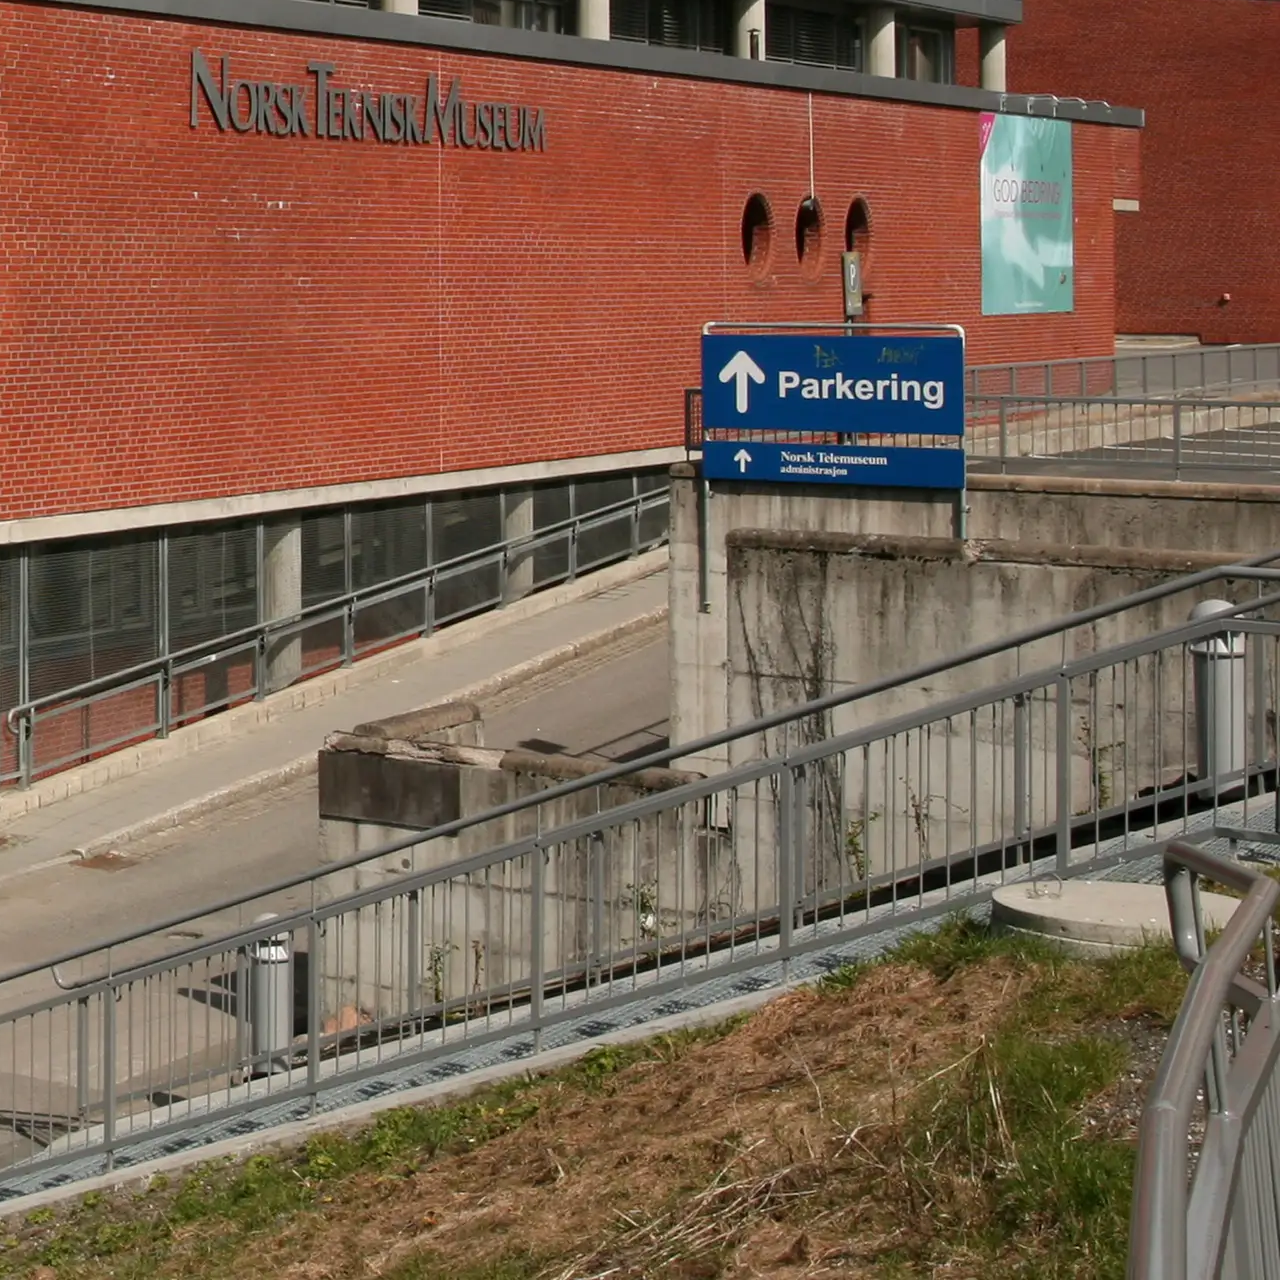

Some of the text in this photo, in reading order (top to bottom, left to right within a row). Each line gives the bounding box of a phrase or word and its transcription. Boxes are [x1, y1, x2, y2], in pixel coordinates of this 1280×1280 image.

[993, 179, 1019, 203] GOD
[778, 371, 944, 409] Parkering
[780, 451, 888, 466] Norsk Telemuseum
[780, 464, 848, 477] administrasjon
